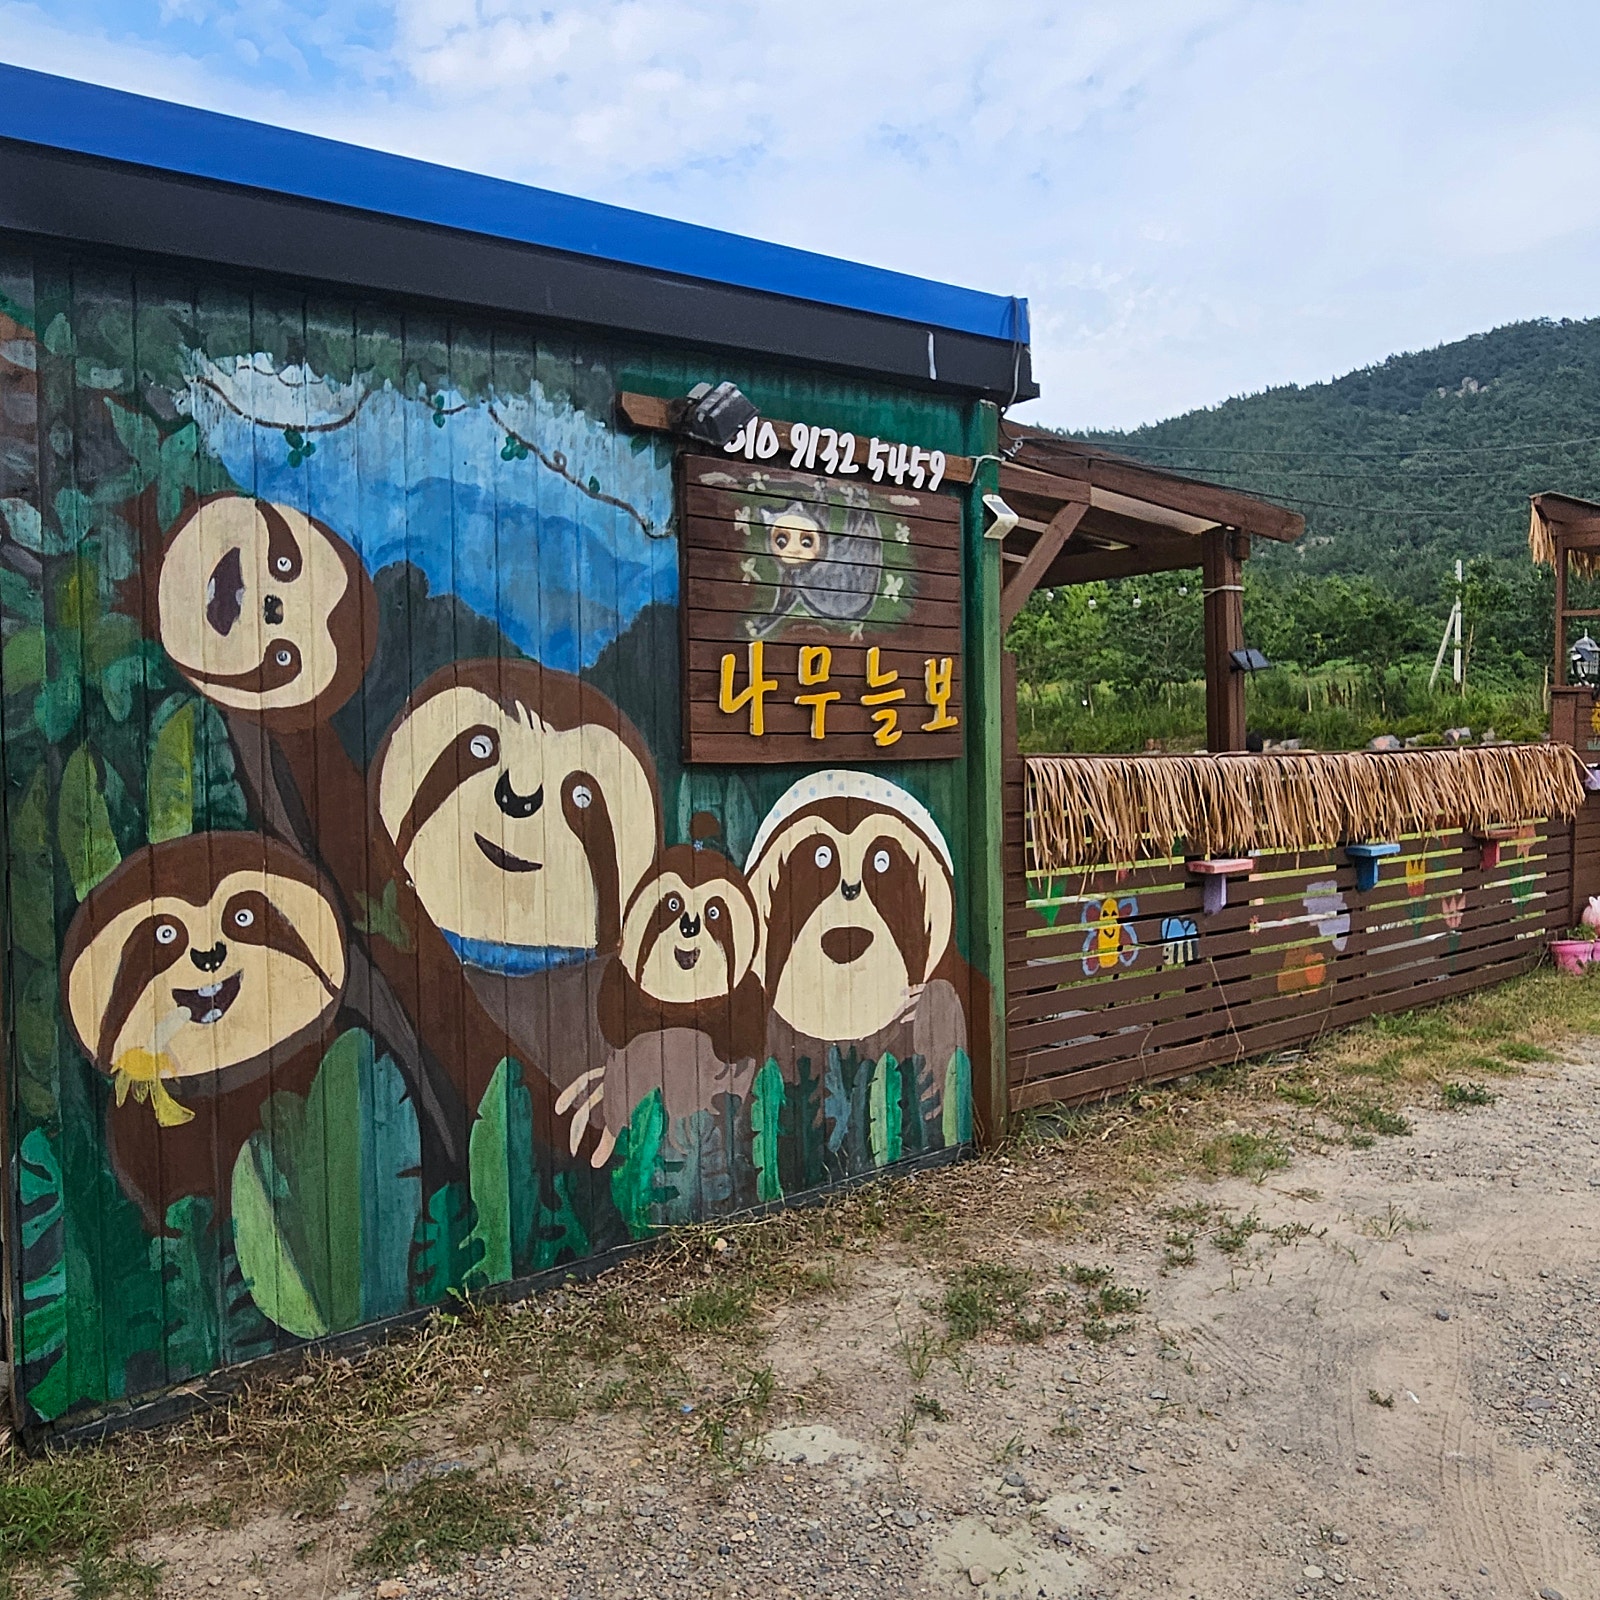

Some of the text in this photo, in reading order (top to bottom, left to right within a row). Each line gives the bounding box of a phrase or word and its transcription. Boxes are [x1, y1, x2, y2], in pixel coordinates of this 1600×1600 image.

[790, 422, 859, 475] 9132
[867, 437, 946, 492] 5459
[718, 640, 959, 747] 나무늘보
